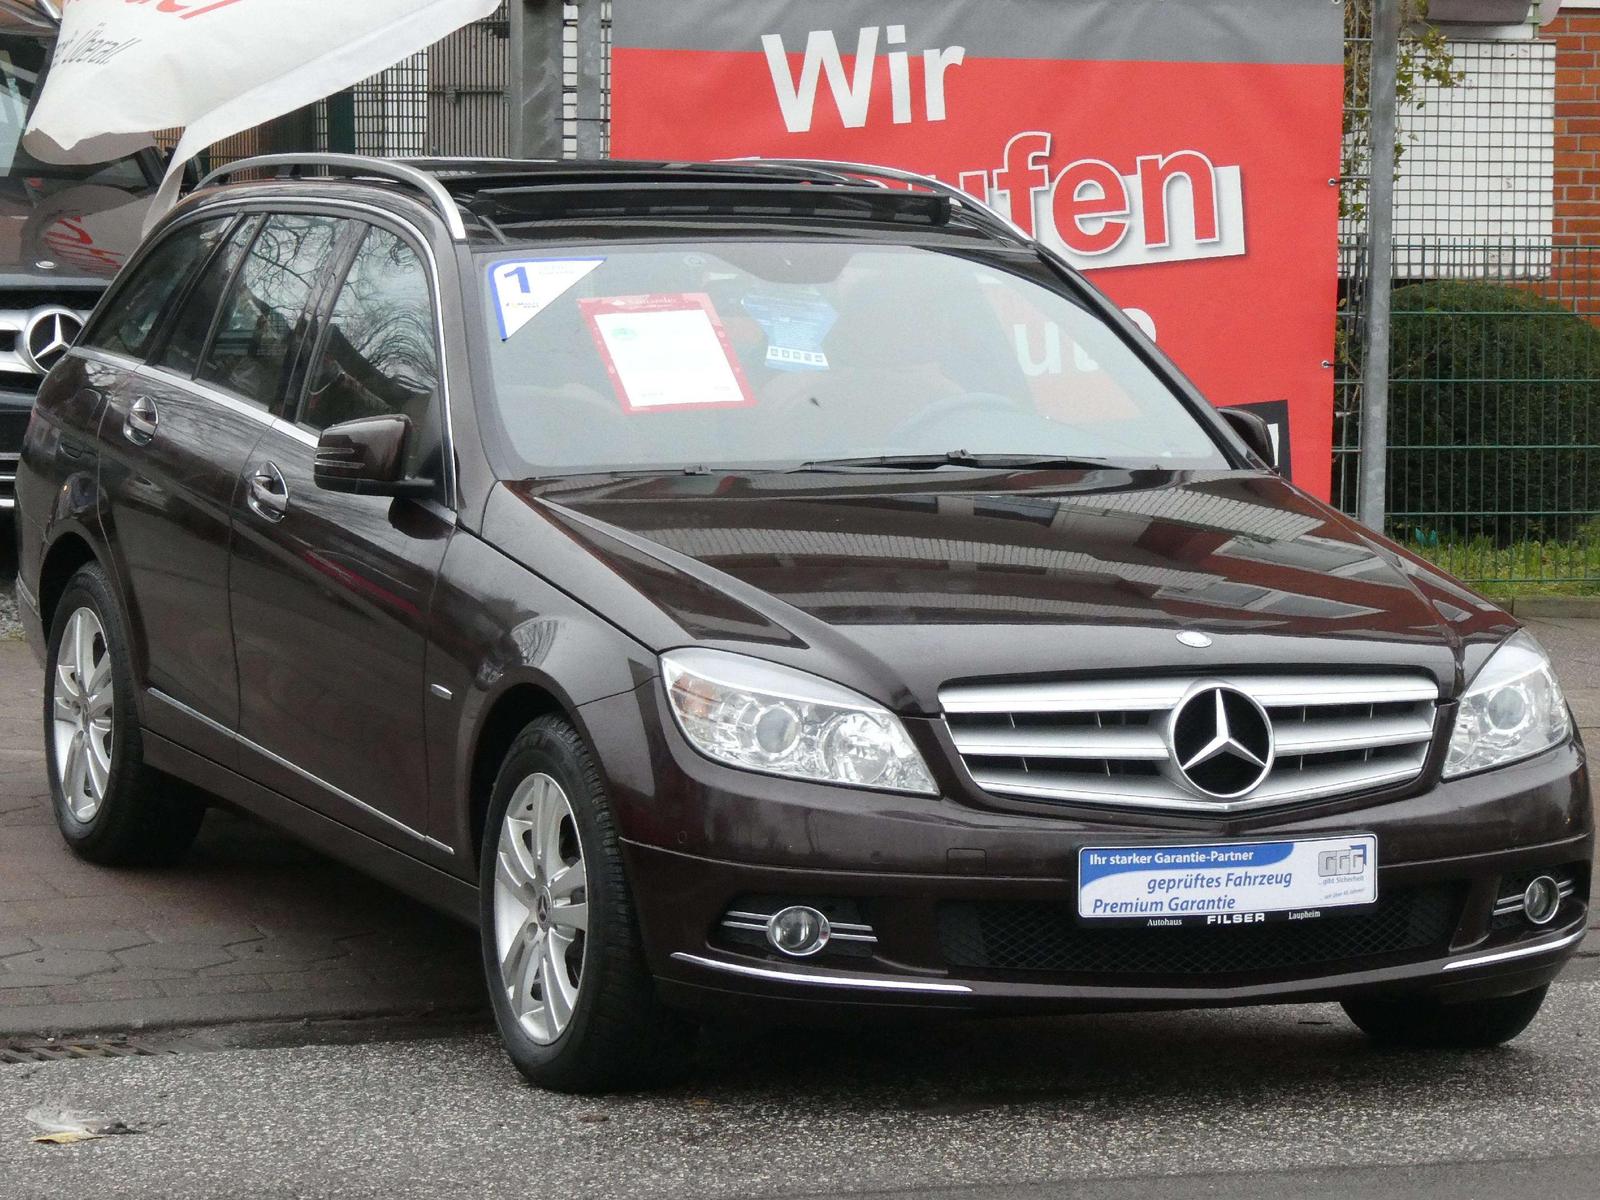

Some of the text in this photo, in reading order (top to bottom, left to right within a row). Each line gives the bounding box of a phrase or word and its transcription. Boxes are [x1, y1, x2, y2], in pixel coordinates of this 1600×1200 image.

[761, 24, 965, 133] Wir
[504, 266, 531, 294] 1
[1090, 851, 1254, 865] Ihr starker Garantie-Partner
[1147, 872, 1292, 894] geprüftes Fahrzeug
[1093, 894, 1236, 913] Premium Garantie
[1147, 918, 1182, 927] Autohaus
[1207, 913, 1265, 924] FILSER
[1288, 911, 1320, 921] Laupheim
